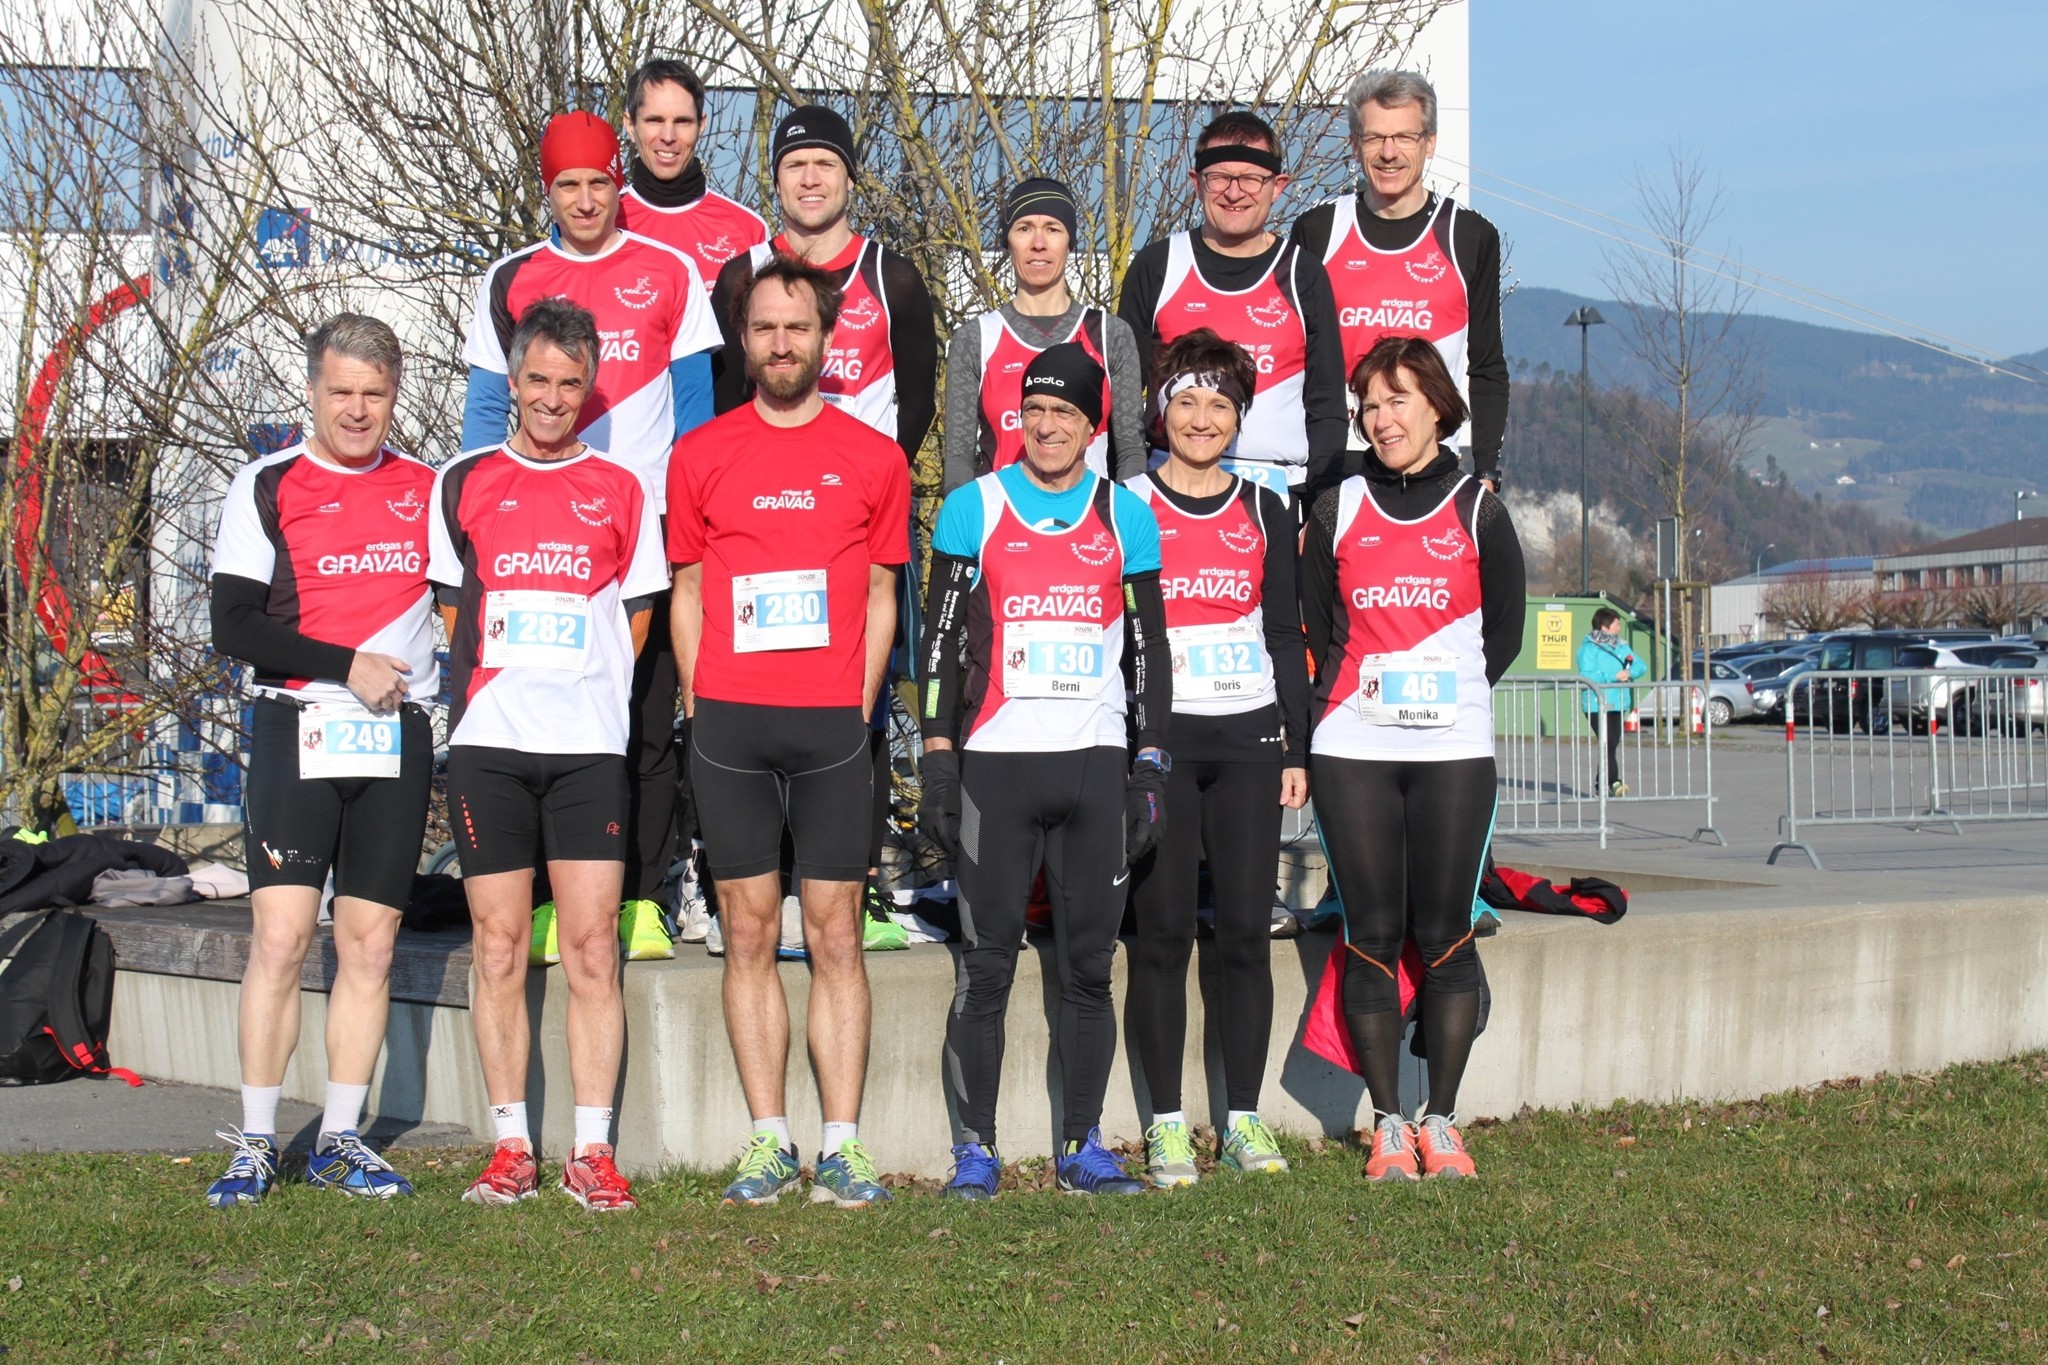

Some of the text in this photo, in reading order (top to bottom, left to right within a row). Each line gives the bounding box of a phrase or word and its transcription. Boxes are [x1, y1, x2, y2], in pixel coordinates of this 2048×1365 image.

[1381, 299, 1413, 308] erdgas
[1339, 307, 1433, 330] GRAVAG
[599, 340, 640, 361] VAG
[1033, 377, 1065, 387] odlo
[753, 496, 815, 510] GRAVAG
[365, 542, 402, 552] erdgas
[537, 541, 573, 552] erdgas
[317, 551, 420, 575] GRAVAG
[494, 552, 592, 580] GRAVAG
[1199, 567, 1236, 577] erdgas
[1048, 584, 1085, 595] erdgas
[1159, 577, 1252, 602] GRAVAG
[1394, 575, 1432, 586] erdgas
[765, 593, 821, 625] 280
[1003, 594, 1103, 619] GRAVAG
[1351, 586, 1451, 611] GRAVAG
[517, 612, 577, 646] 282
[1041, 643, 1095, 675] 130
[1200, 644, 1252, 674] 132
[1052, 680, 1080, 692] Berni
[1214, 680, 1241, 692] Doris
[1402, 673, 1438, 703] 46
[1398, 709, 1439, 721] Monika
[337, 722, 392, 753] 249
